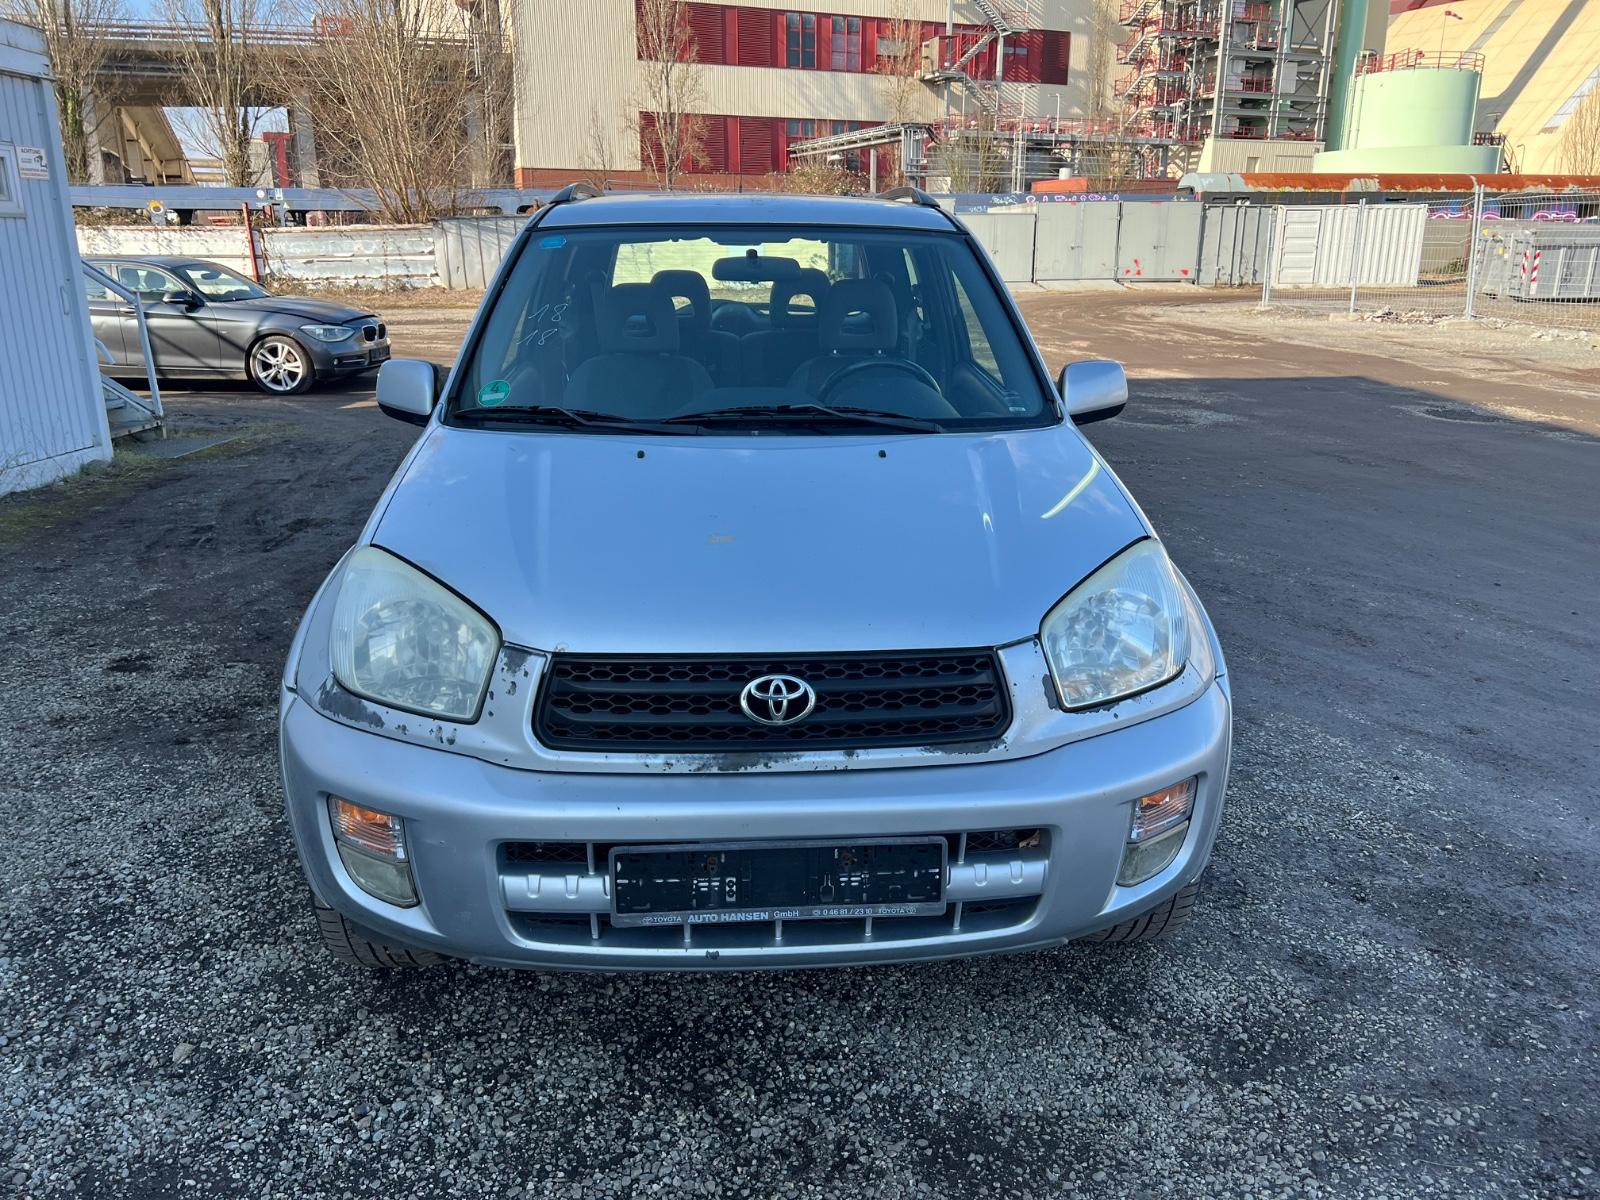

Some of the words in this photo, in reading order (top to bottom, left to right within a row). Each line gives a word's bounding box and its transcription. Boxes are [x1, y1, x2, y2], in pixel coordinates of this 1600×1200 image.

[528, 303, 569, 322] 18
[516, 328, 558, 346] 18
[490, 382, 501, 394] 4
[687, 913, 719, 923] AUTO
[720, 911, 769, 922] HANSEN
[773, 910, 799, 918] GmbH
